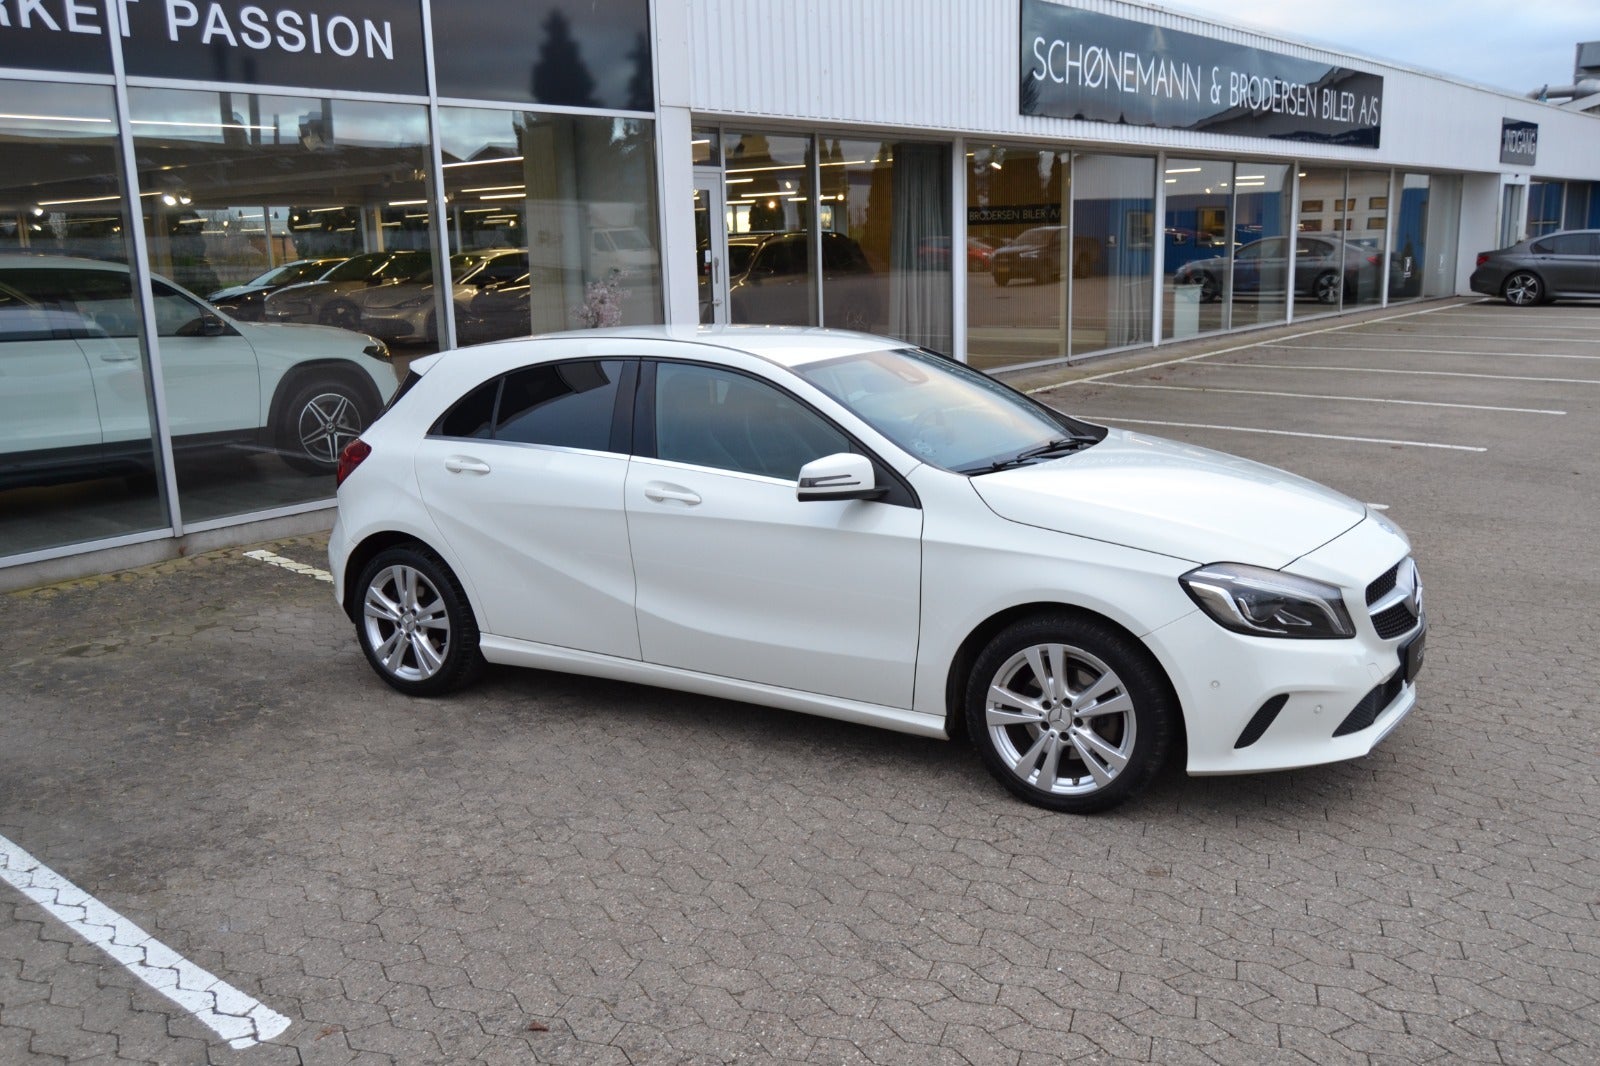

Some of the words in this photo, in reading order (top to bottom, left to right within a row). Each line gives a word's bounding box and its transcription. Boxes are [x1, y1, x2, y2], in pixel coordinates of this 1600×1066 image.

[165, 0, 394, 60] PASSION
[1032, 36, 1201, 101] SCHØNEMANN
[1210, 66, 1222, 105] &
[1229, 71, 1318, 119] BRODERSEN
[1322, 88, 1355, 122] BILER
[1358, 95, 1380, 126] A/S
[969, 209, 1020, 221] BRODERSEN
[1023, 208, 1046, 219] BILER
